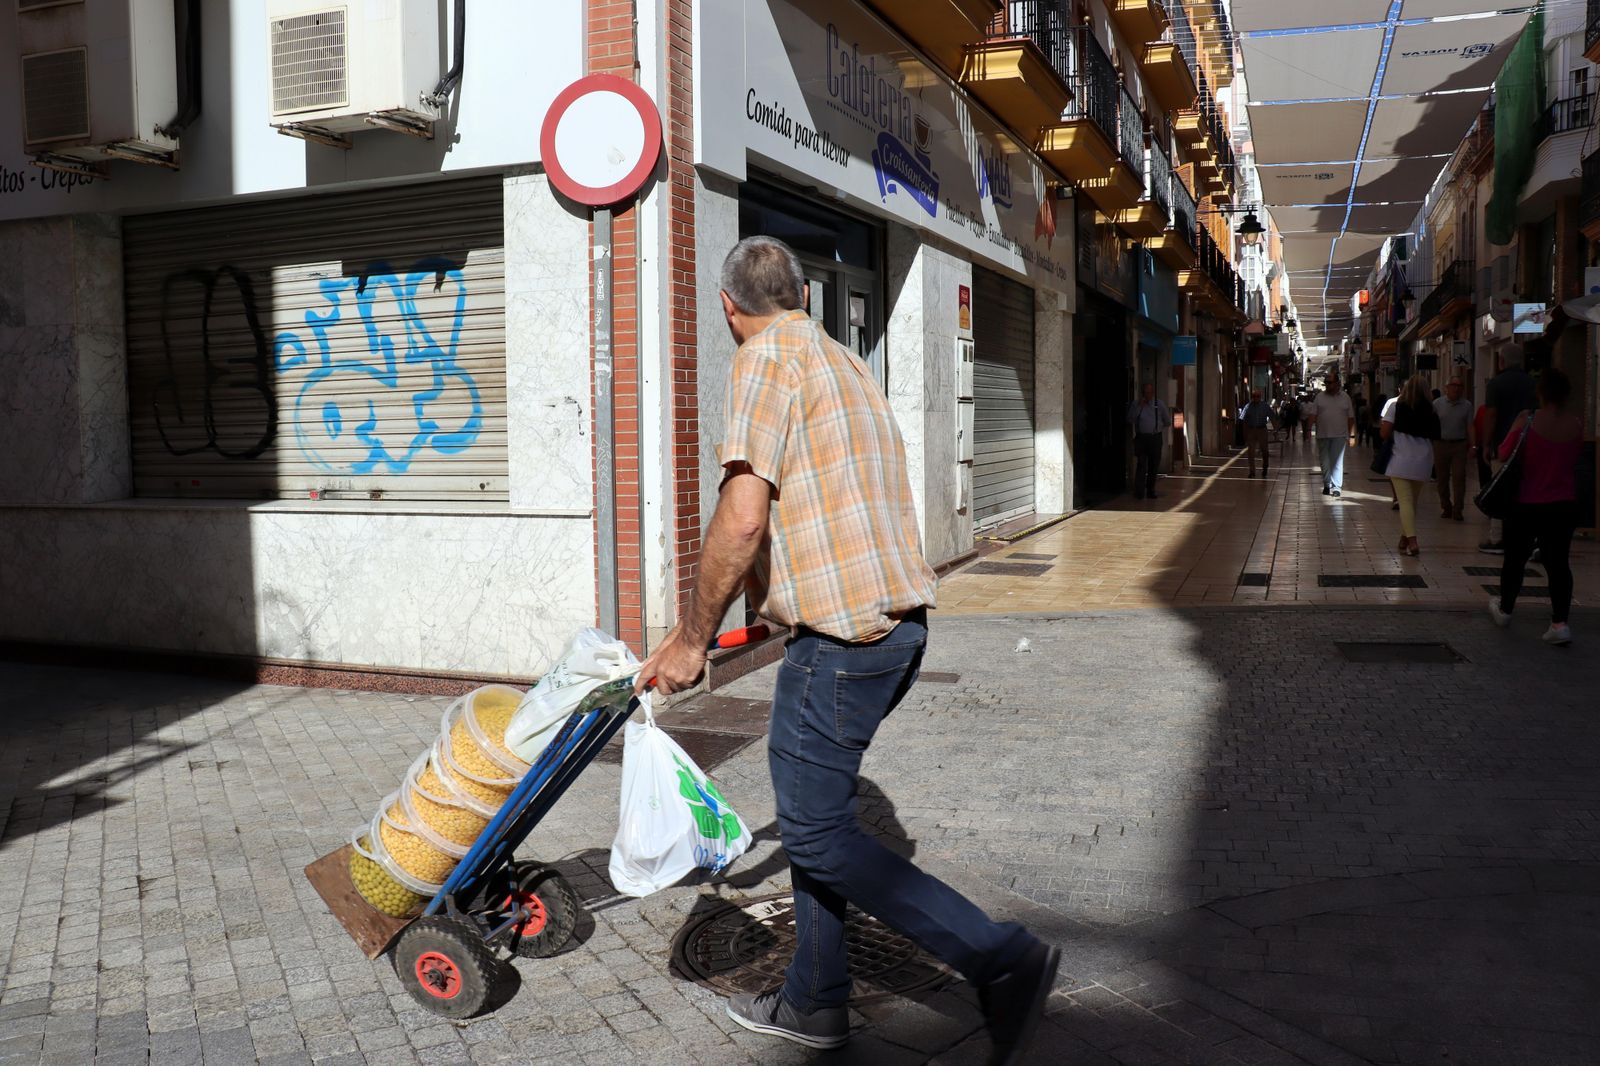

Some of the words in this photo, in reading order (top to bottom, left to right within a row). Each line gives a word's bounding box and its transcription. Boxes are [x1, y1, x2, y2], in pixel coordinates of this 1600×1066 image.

[826, 22, 912, 145] Cafetería
[1402, 47, 1459, 56] HUELVA
[746, 87, 792, 139] Comida
[794, 121, 819, 154] para
[822, 130, 851, 168] llevar
